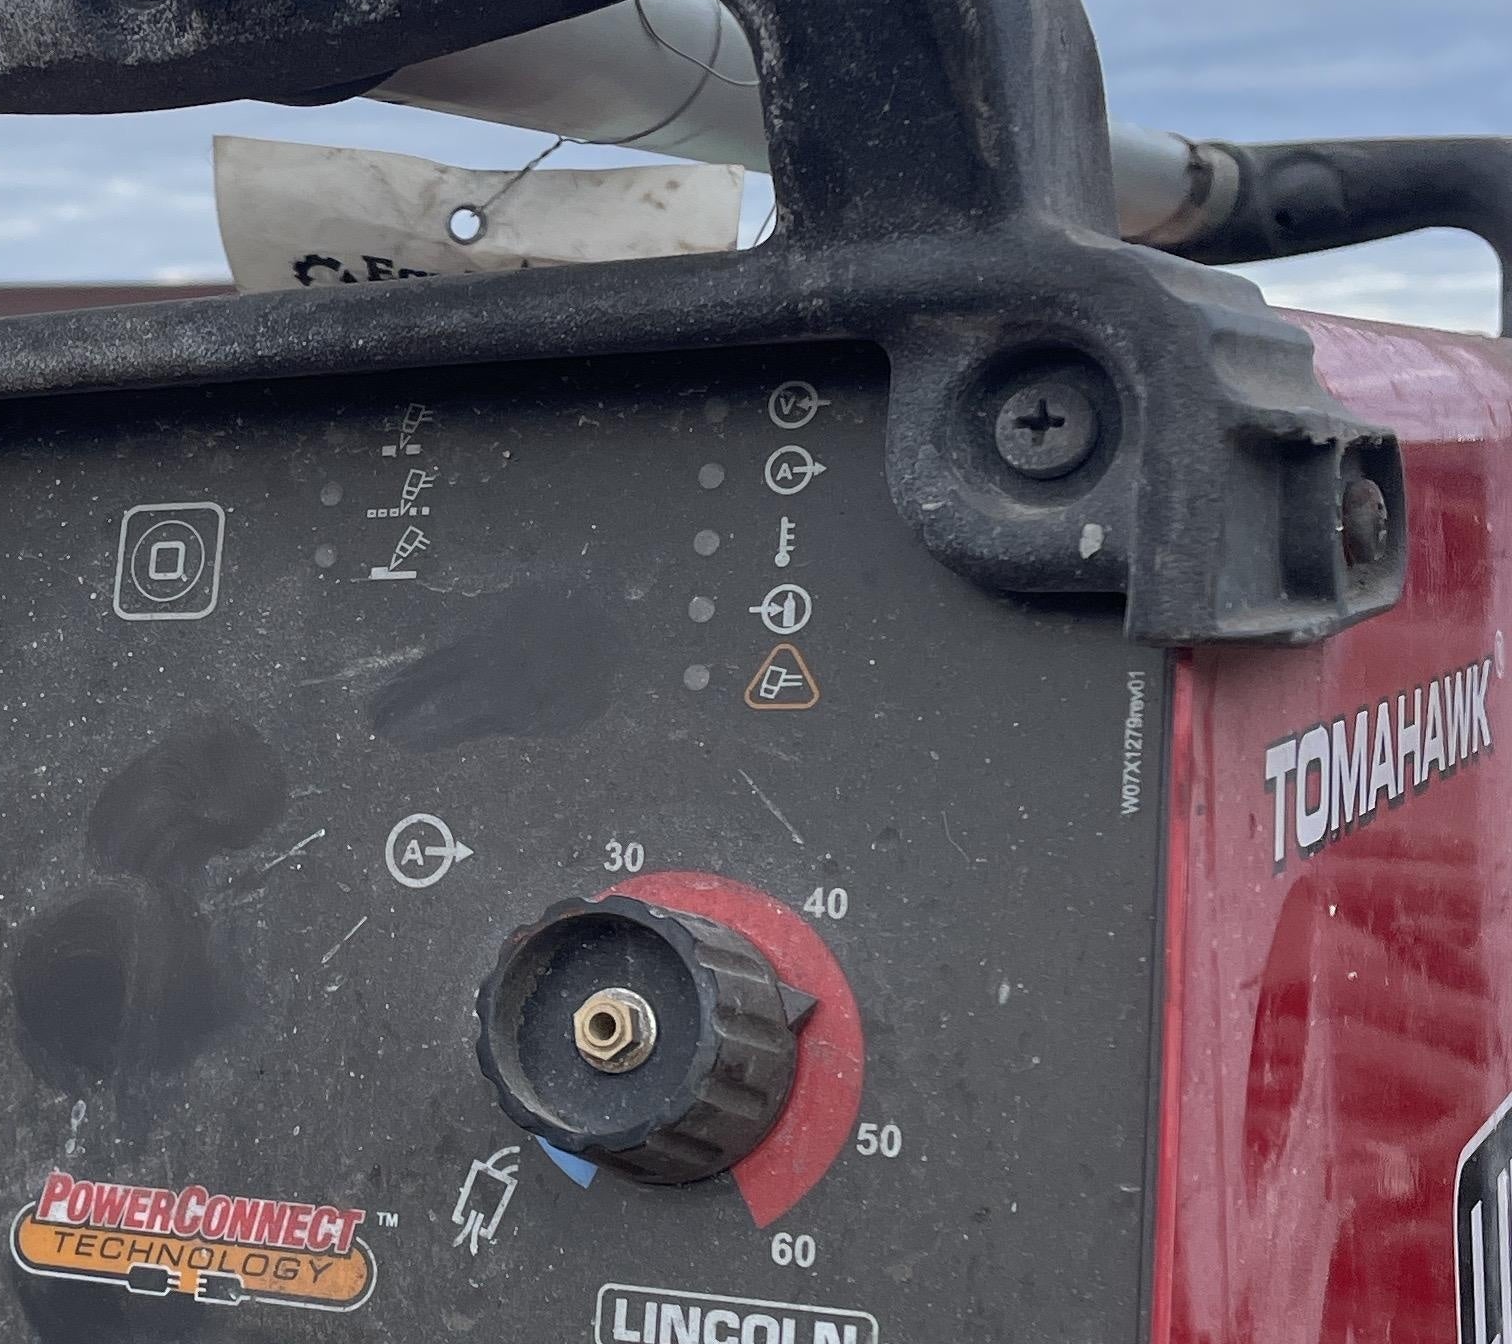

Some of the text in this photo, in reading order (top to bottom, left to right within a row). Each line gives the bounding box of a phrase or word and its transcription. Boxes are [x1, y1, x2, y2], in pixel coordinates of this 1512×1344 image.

[1265, 658, 1492, 862] TOMAHAWK
[604, 842, 644, 872] 30
[804, 887, 849, 920] 40
[857, 1123, 902, 1158] 50
[54, 1231, 334, 1283] TECHNOLOGY
[771, 1233, 816, 1268] 60
